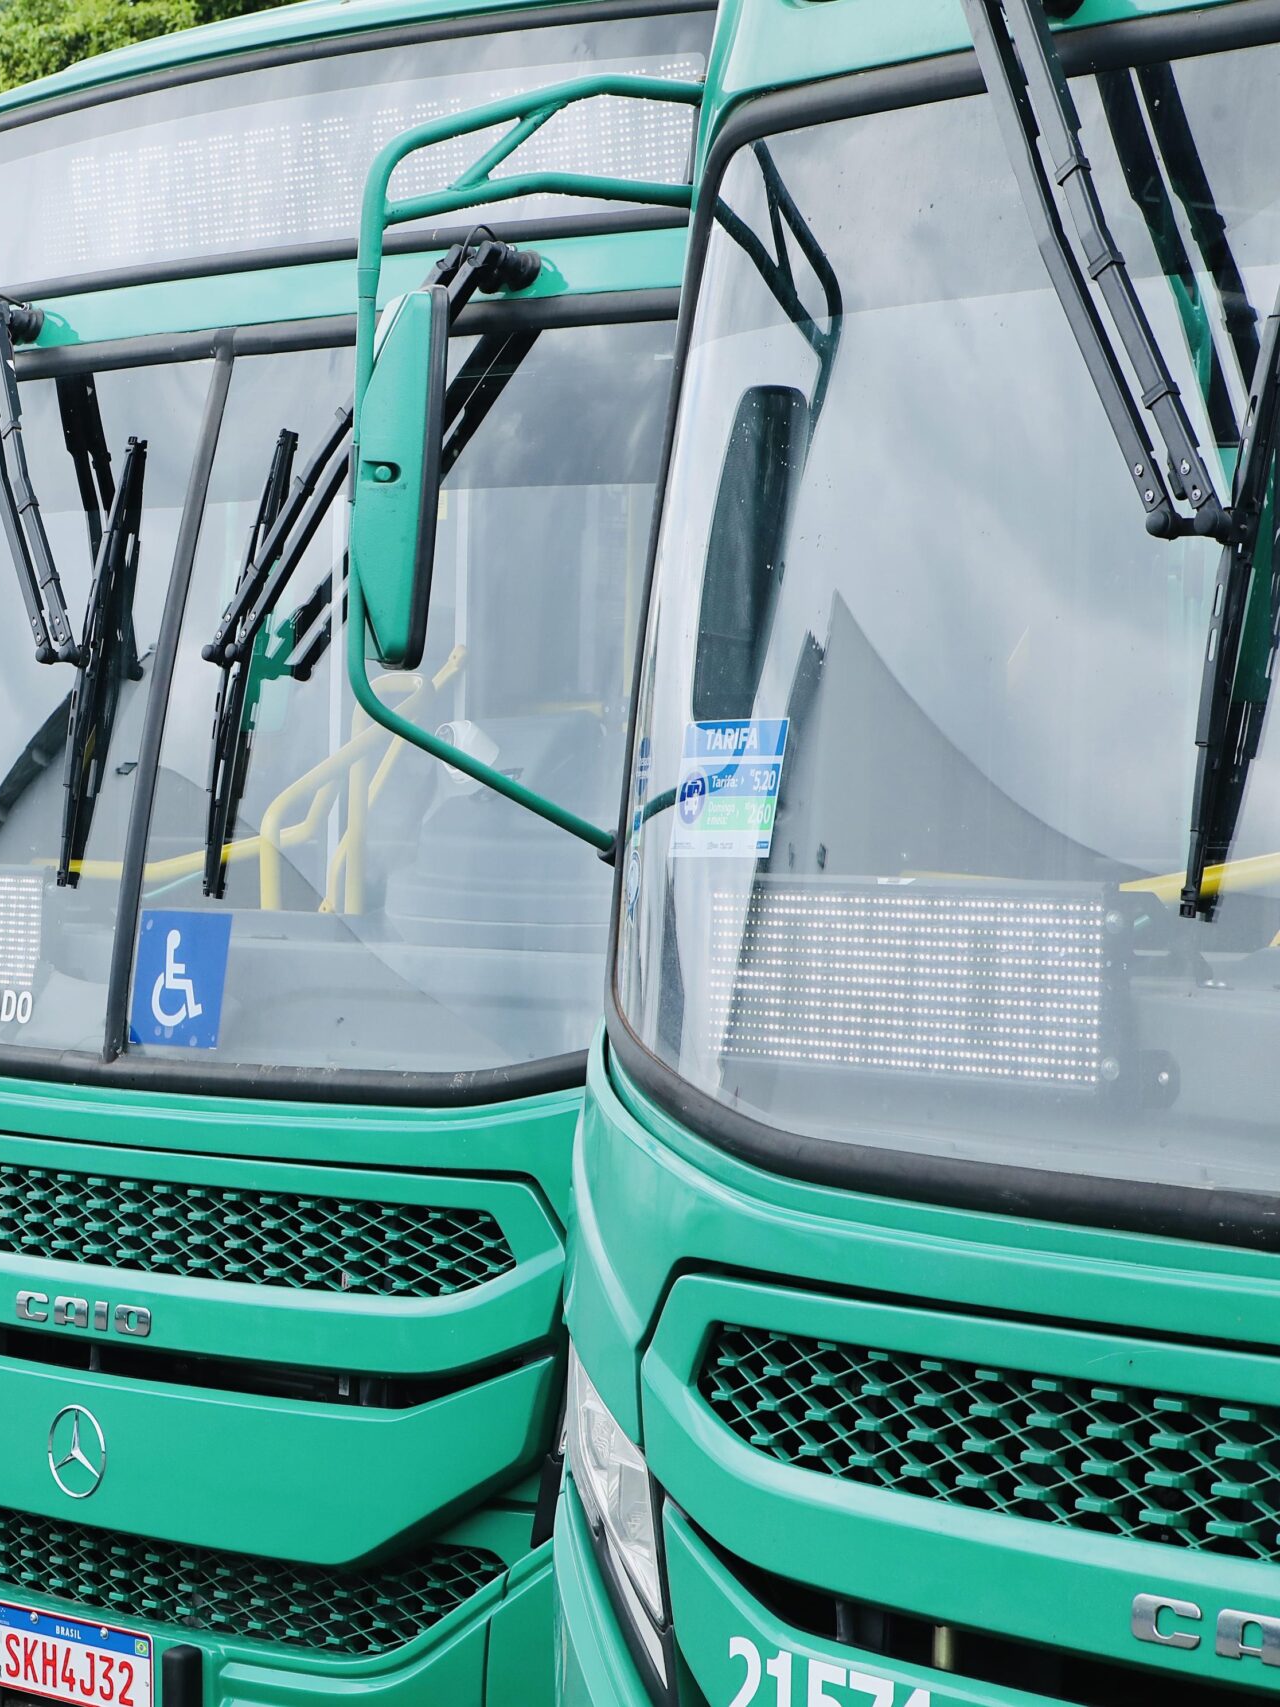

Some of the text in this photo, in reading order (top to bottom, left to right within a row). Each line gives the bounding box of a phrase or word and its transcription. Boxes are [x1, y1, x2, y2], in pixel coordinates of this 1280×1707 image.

[706, 727, 758, 751] TARIFA
[711, 775, 739, 788] Tarifa:
[15, 1290, 152, 1338] CAIO
[55, 1625, 82, 1640] BRASIL
[5, 1633, 134, 1707] SKH4J32
